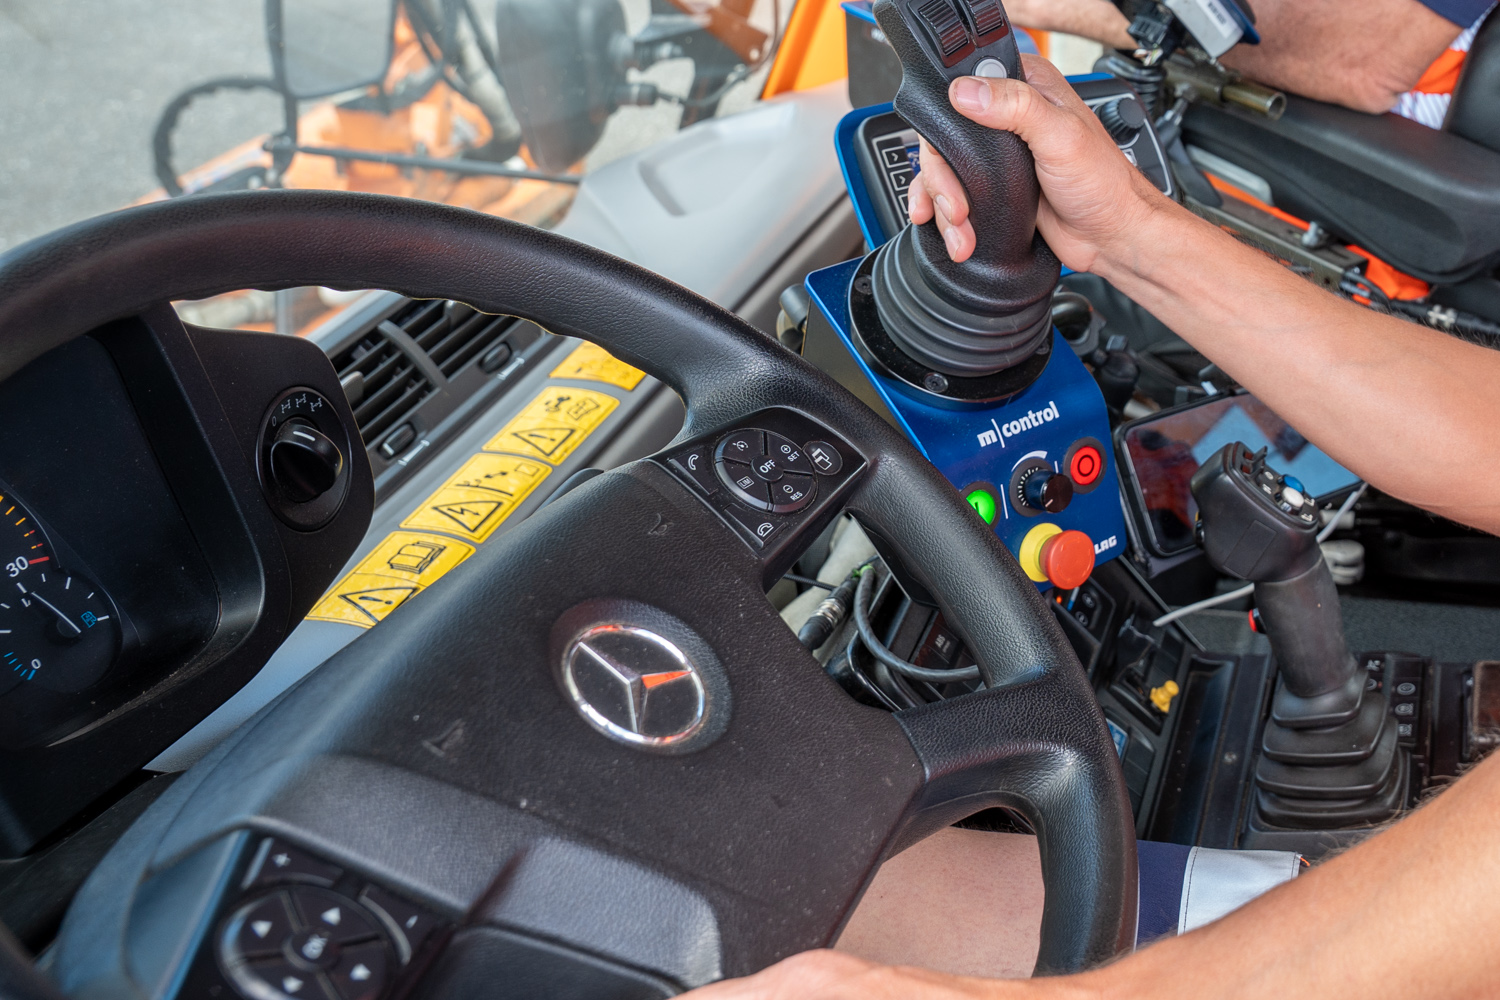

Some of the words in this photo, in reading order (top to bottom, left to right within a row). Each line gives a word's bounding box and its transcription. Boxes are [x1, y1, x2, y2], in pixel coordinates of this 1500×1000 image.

[787, 451, 800, 462] SET
[759, 459, 776, 473] OFF
[790, 491, 803, 501] RES
[6, 556, 29, 577] 30
